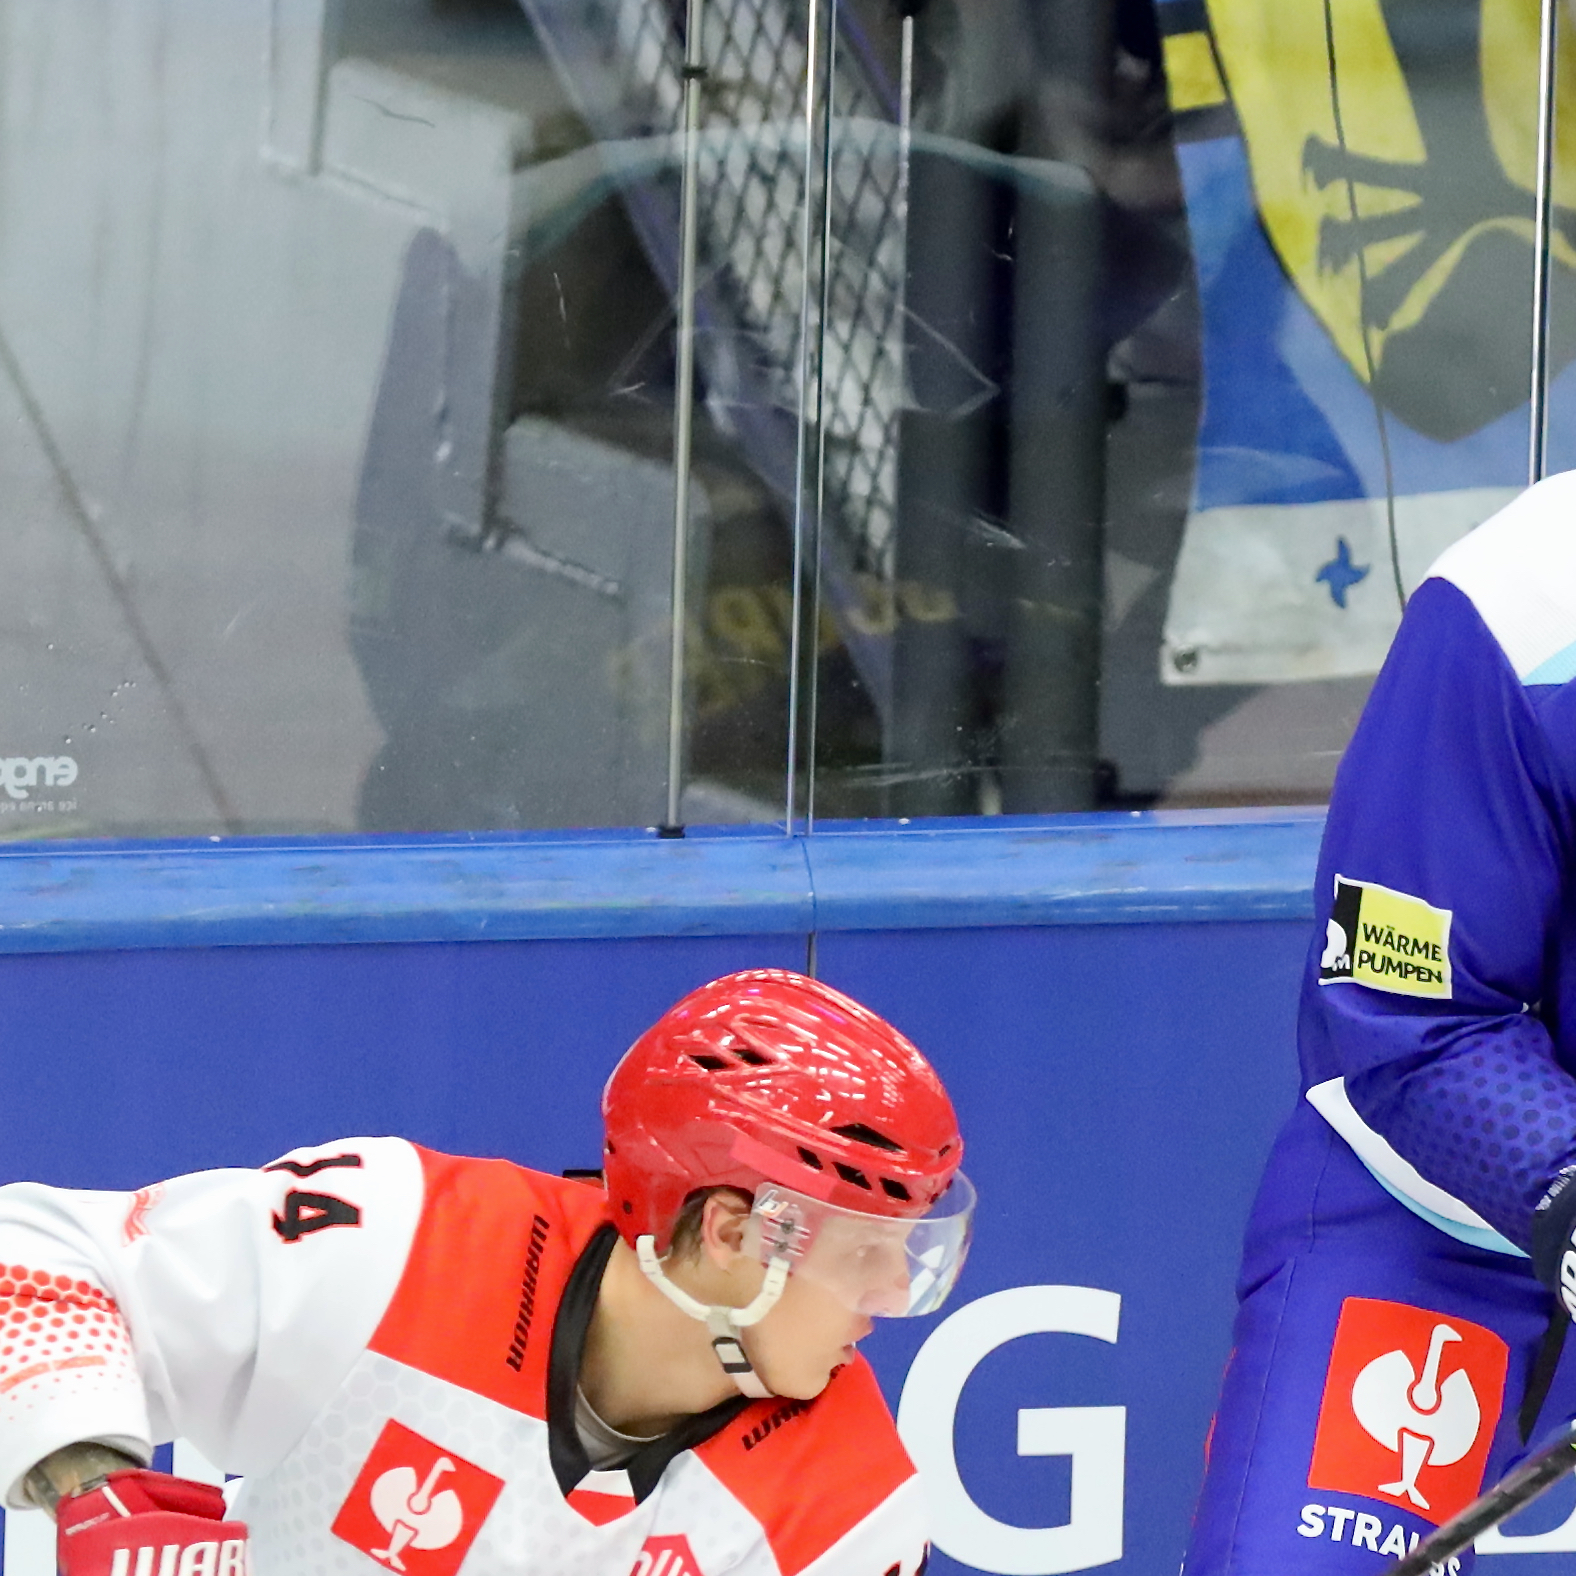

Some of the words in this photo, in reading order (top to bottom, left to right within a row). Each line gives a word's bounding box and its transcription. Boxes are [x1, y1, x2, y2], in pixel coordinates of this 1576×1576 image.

[1362, 923, 1443, 962] WÄRME
[1357, 950, 1443, 984] PUMPEN
[506, 1214, 550, 1373] WARRIOR
